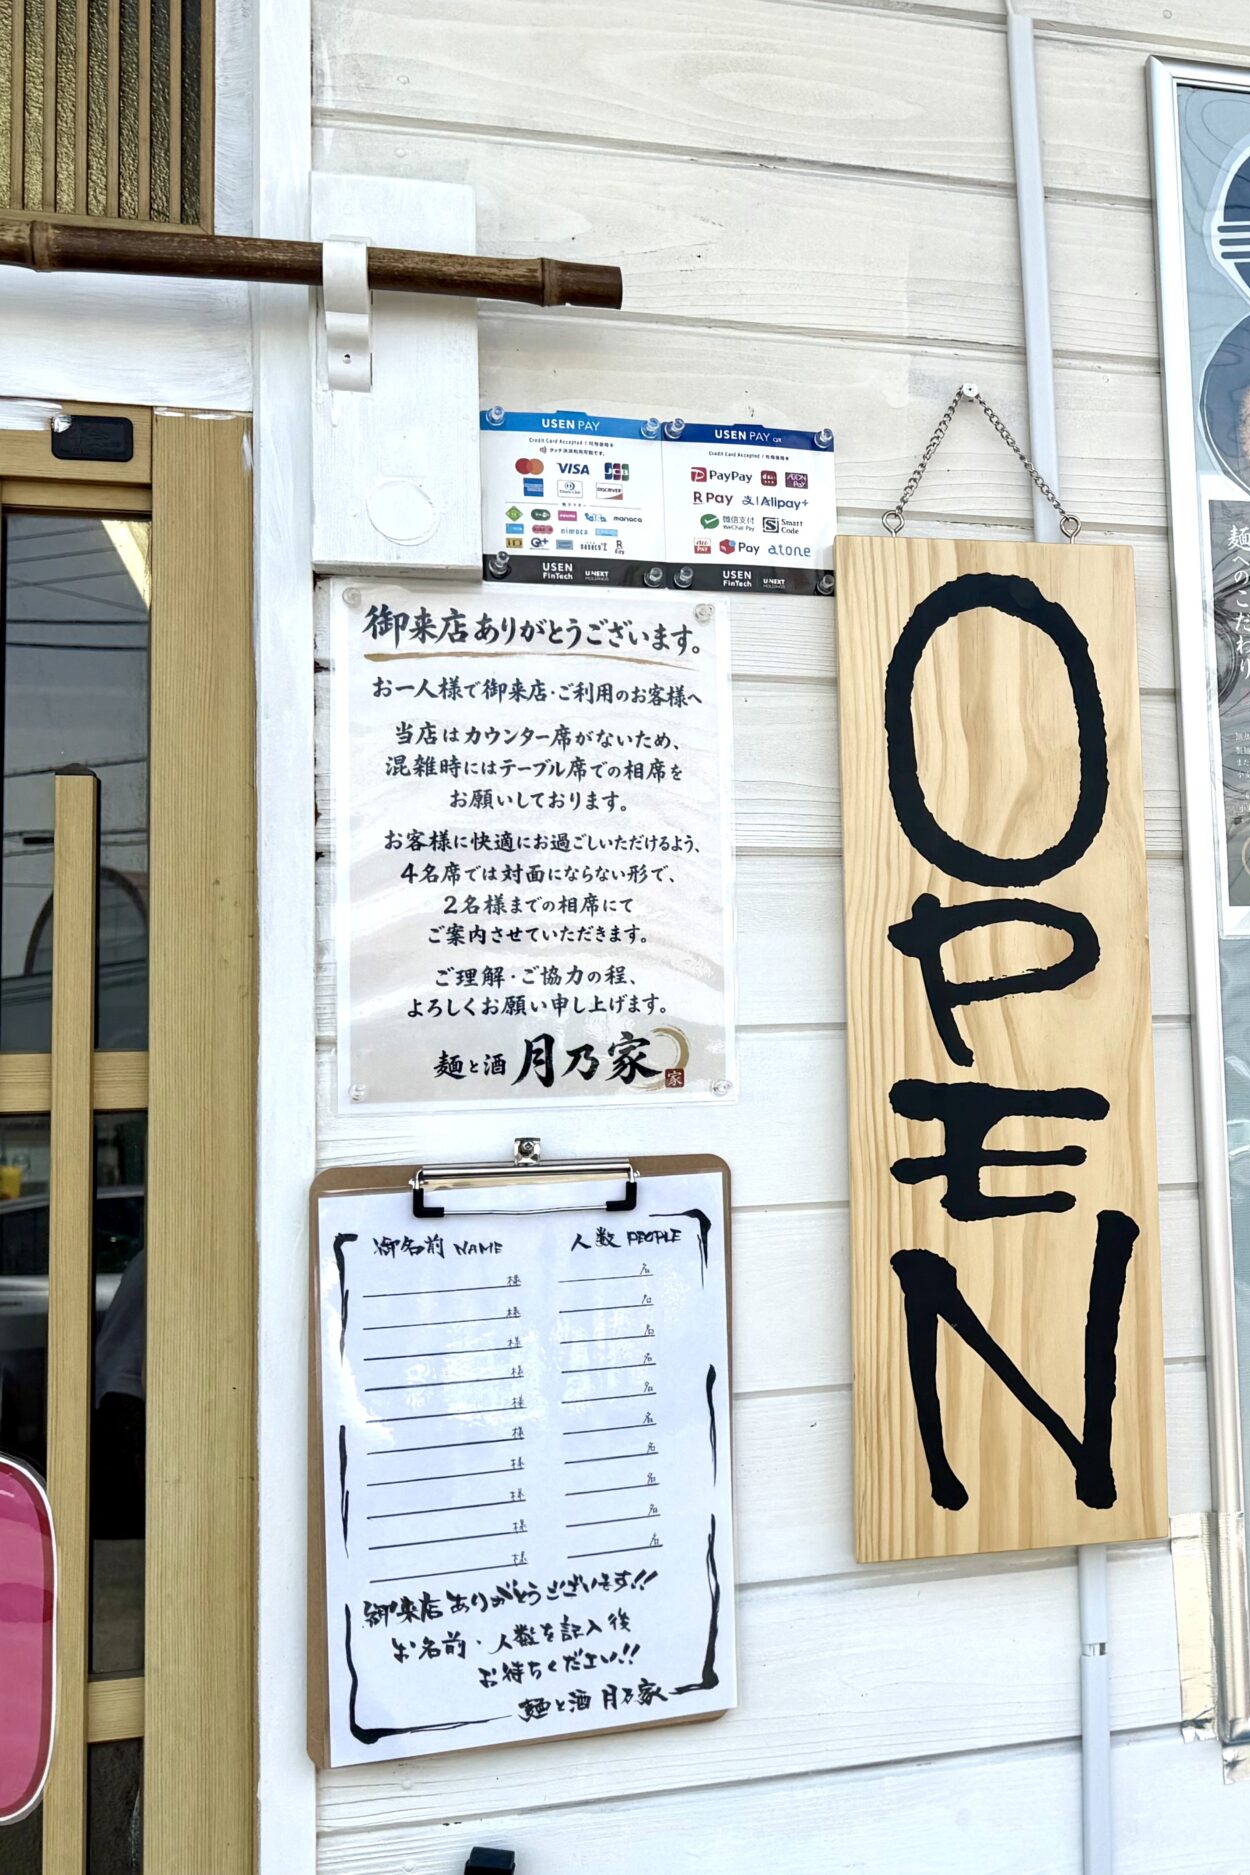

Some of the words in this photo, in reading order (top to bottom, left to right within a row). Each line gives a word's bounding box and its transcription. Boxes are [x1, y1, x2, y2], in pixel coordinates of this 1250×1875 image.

[541, 418, 576, 430] USEN
[578, 420, 600, 432] PAY
[715, 429, 747, 440] USEN
[749, 432, 770, 443] PAY
[556, 462, 590, 475] VISA
[709, 469, 753, 484] PayPay
[705, 492, 734, 507] Pay
[780, 519, 803, 528] Smart
[780, 526, 800, 535] Code
[738, 542, 760, 555] Pay
[768, 544, 812, 557] atone
[542, 563, 573, 572] USEN
[542, 572, 573, 580] FinTech
[722, 570, 752, 580] USEN
[722, 580, 752, 588] FinTech
[361, 604, 701, 656] 御来店ありがとうございます。
[372, 675, 703, 708] お一人様で御来店・ご利用のお客様へ
[395, 721, 682, 750] 当店はカウンター席がないため、
[385, 754, 683, 781] 混雑時にはテーブル席での相席を
[449, 788, 628, 813] お願いしております。
[383, 829, 701, 854] お客様に快適にお過ごしいただけるよう、
[400, 862, 676, 885] 4名席では対面にならない形で、
[443, 894, 634, 915] 2名様までの相席にて
[427, 922, 648, 946] ご案内させていただきます。
[435, 965, 637, 988] ご理解・ご協力の程、
[406, 994, 668, 1018] よろしくお願い申し上げます。
[884, 571, 1141, 1512] OPEN
[432, 1049, 507, 1078] 麺と酒
[511, 1030, 664, 1087] 月乃家
[453, 1242, 503, 1256] NAME
[570, 1226, 623, 1251] 人数
[627, 1227, 682, 1244] PEOPLE
